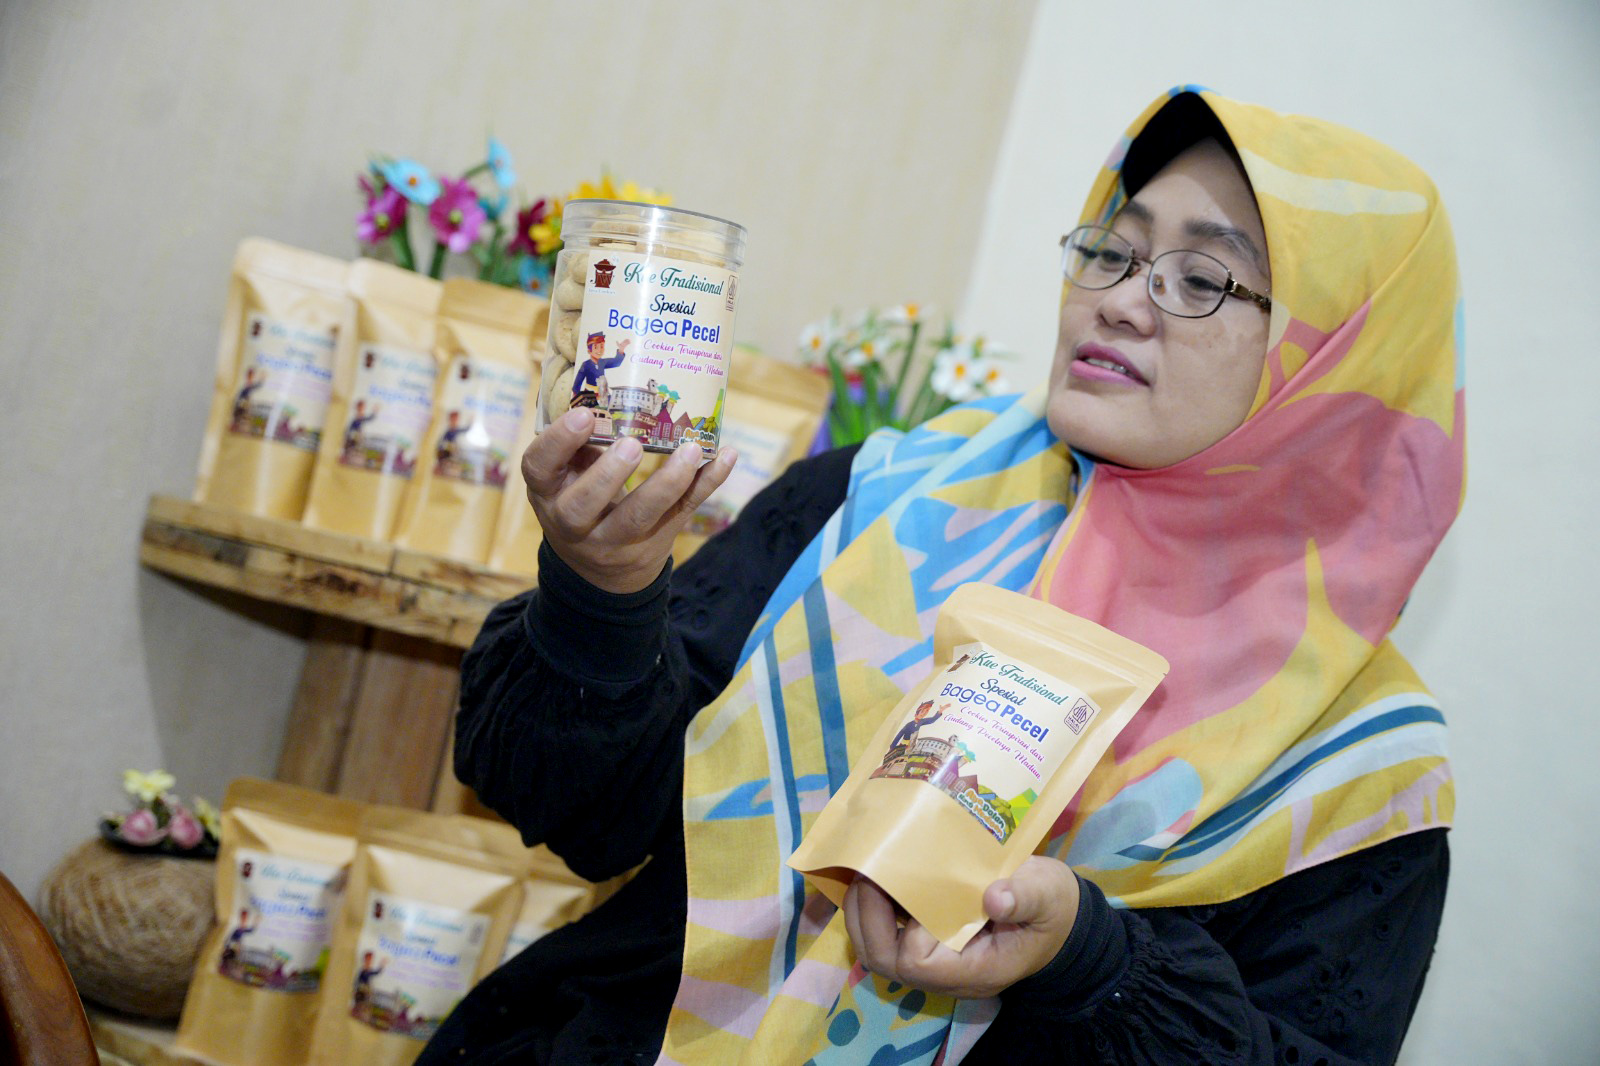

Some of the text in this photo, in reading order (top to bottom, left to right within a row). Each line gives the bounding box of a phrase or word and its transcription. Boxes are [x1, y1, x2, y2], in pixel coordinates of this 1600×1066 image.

[624, 263, 724, 295] Ke Tradisional
[650, 294, 696, 315] Spesial
[608, 309, 720, 343] Bagea Pecel
[643, 340, 674, 352] Cookies
[668, 358, 702, 374] Pecelnya
[969, 650, 1069, 705] Kue Tradisional
[980, 678, 1027, 706] Spesial
[940, 683, 1000, 712] Bagea
[1000, 704, 1049, 743] Pecel
[943, 713, 973, 730] Gudang
[977, 726, 1012, 752] Pecelnya
[960, 706, 988, 723] Cookies
[1030, 748, 1045, 763] dari
